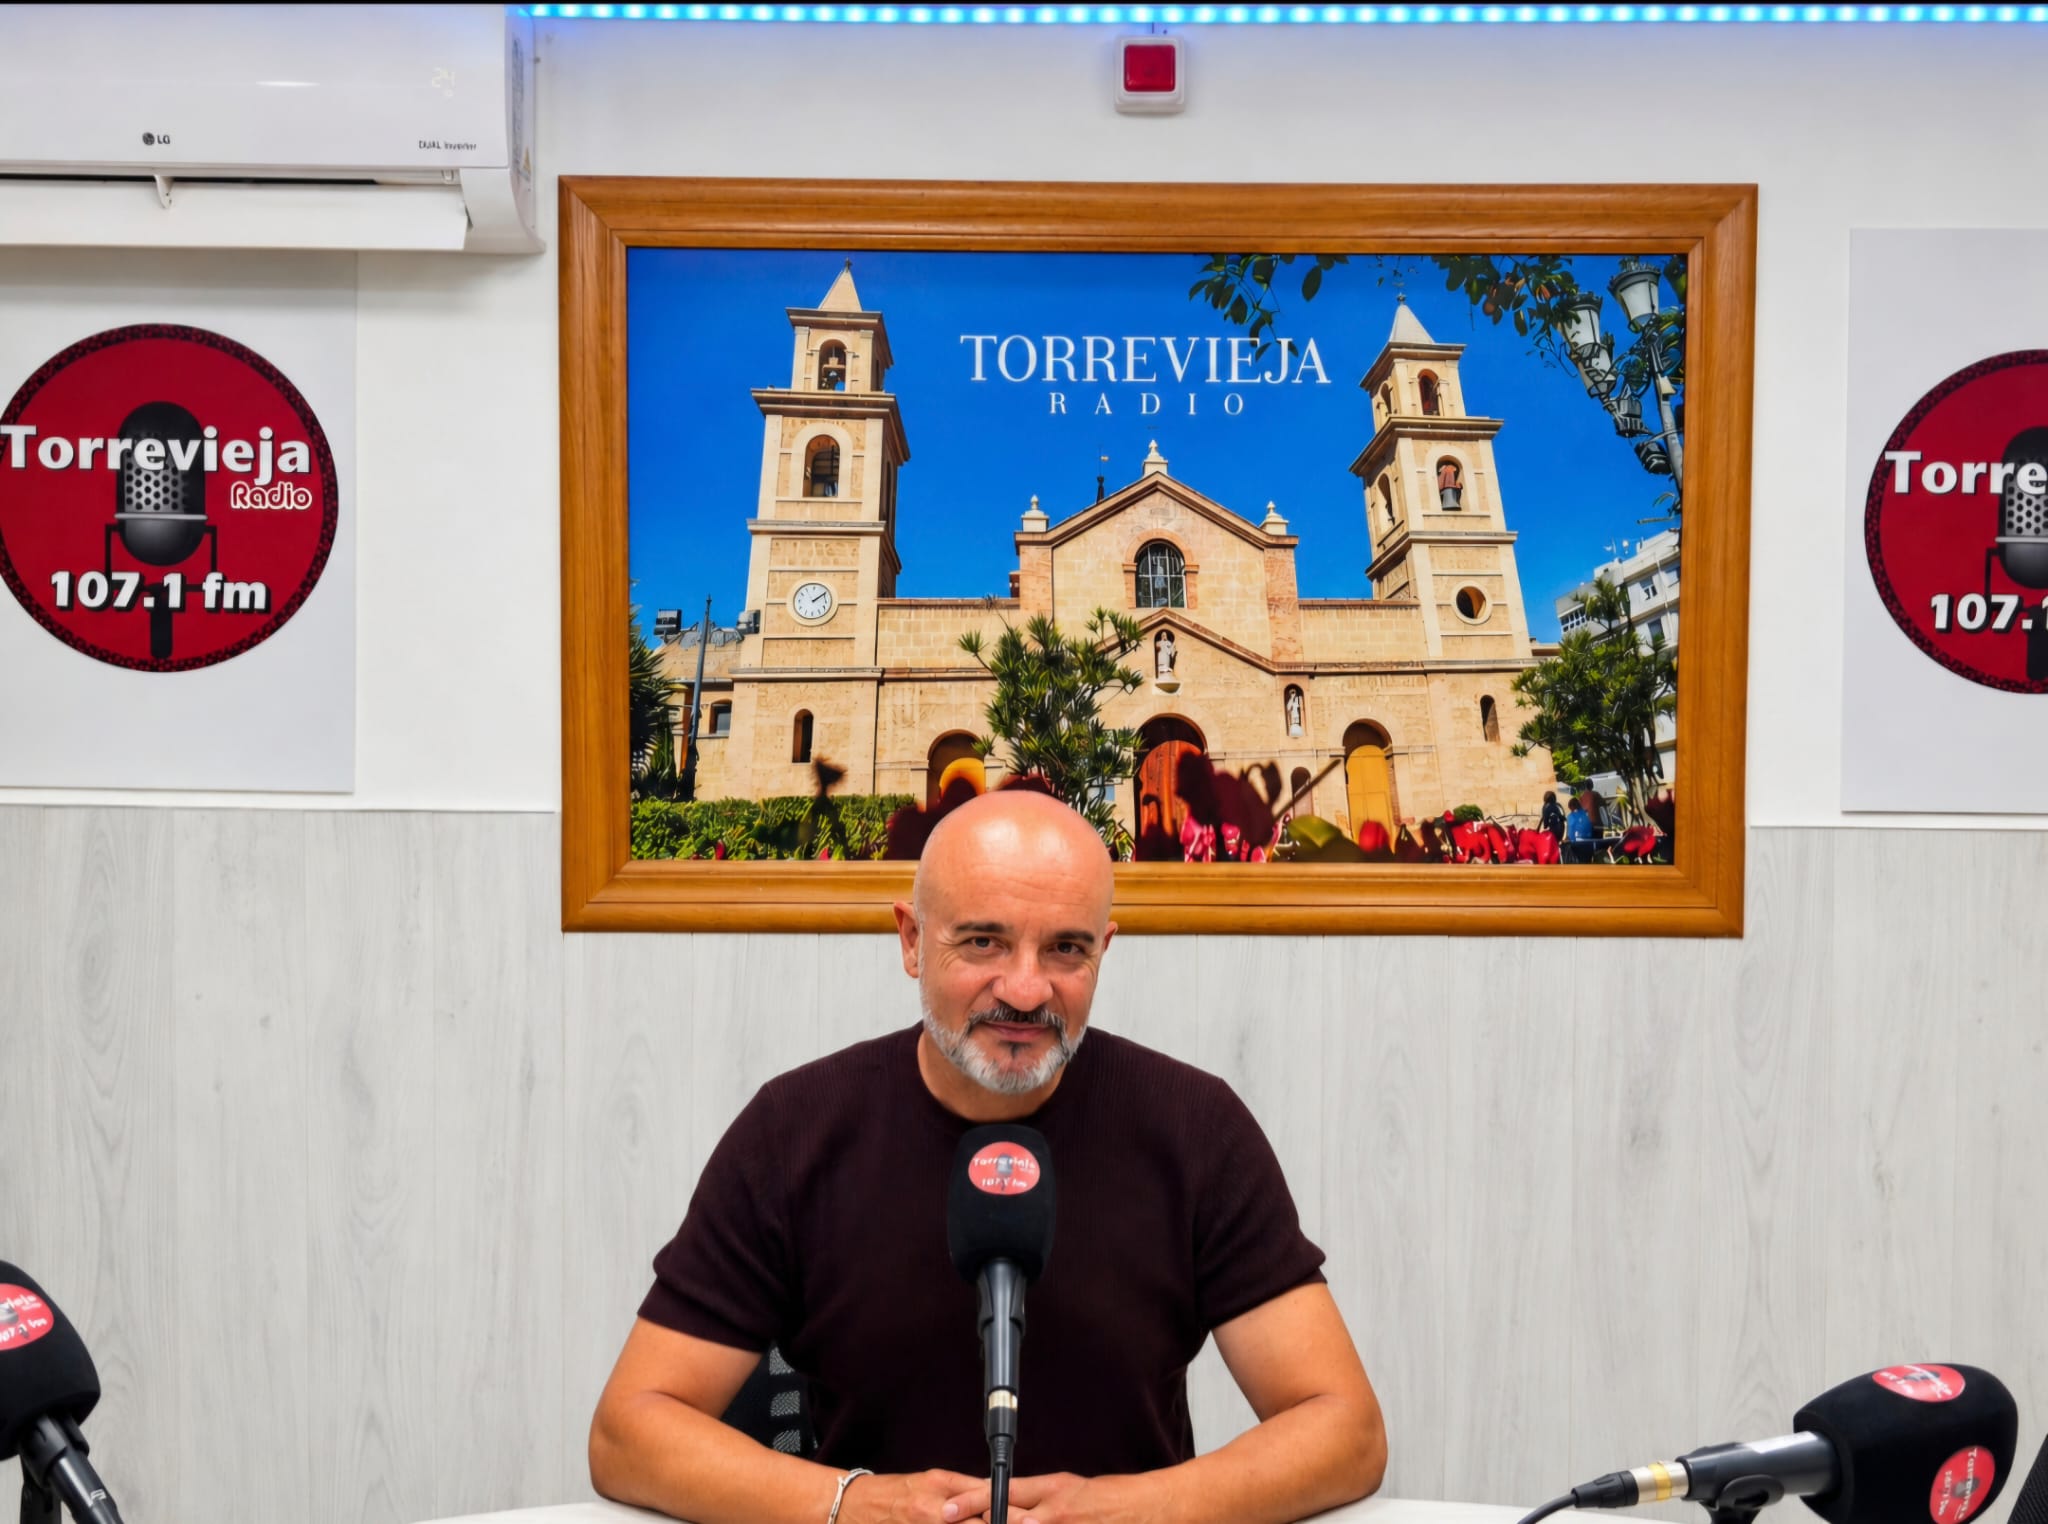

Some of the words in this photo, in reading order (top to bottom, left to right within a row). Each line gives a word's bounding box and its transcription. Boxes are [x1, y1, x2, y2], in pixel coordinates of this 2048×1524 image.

[960, 334, 1332, 384] TORREVIEJA
[0, 424, 311, 486] Torrevieja
[230, 481, 312, 509] Radio
[51, 570, 184, 610] 107.1
[201, 571, 268, 611] fm
[1930, 592, 2048, 631] 107.
